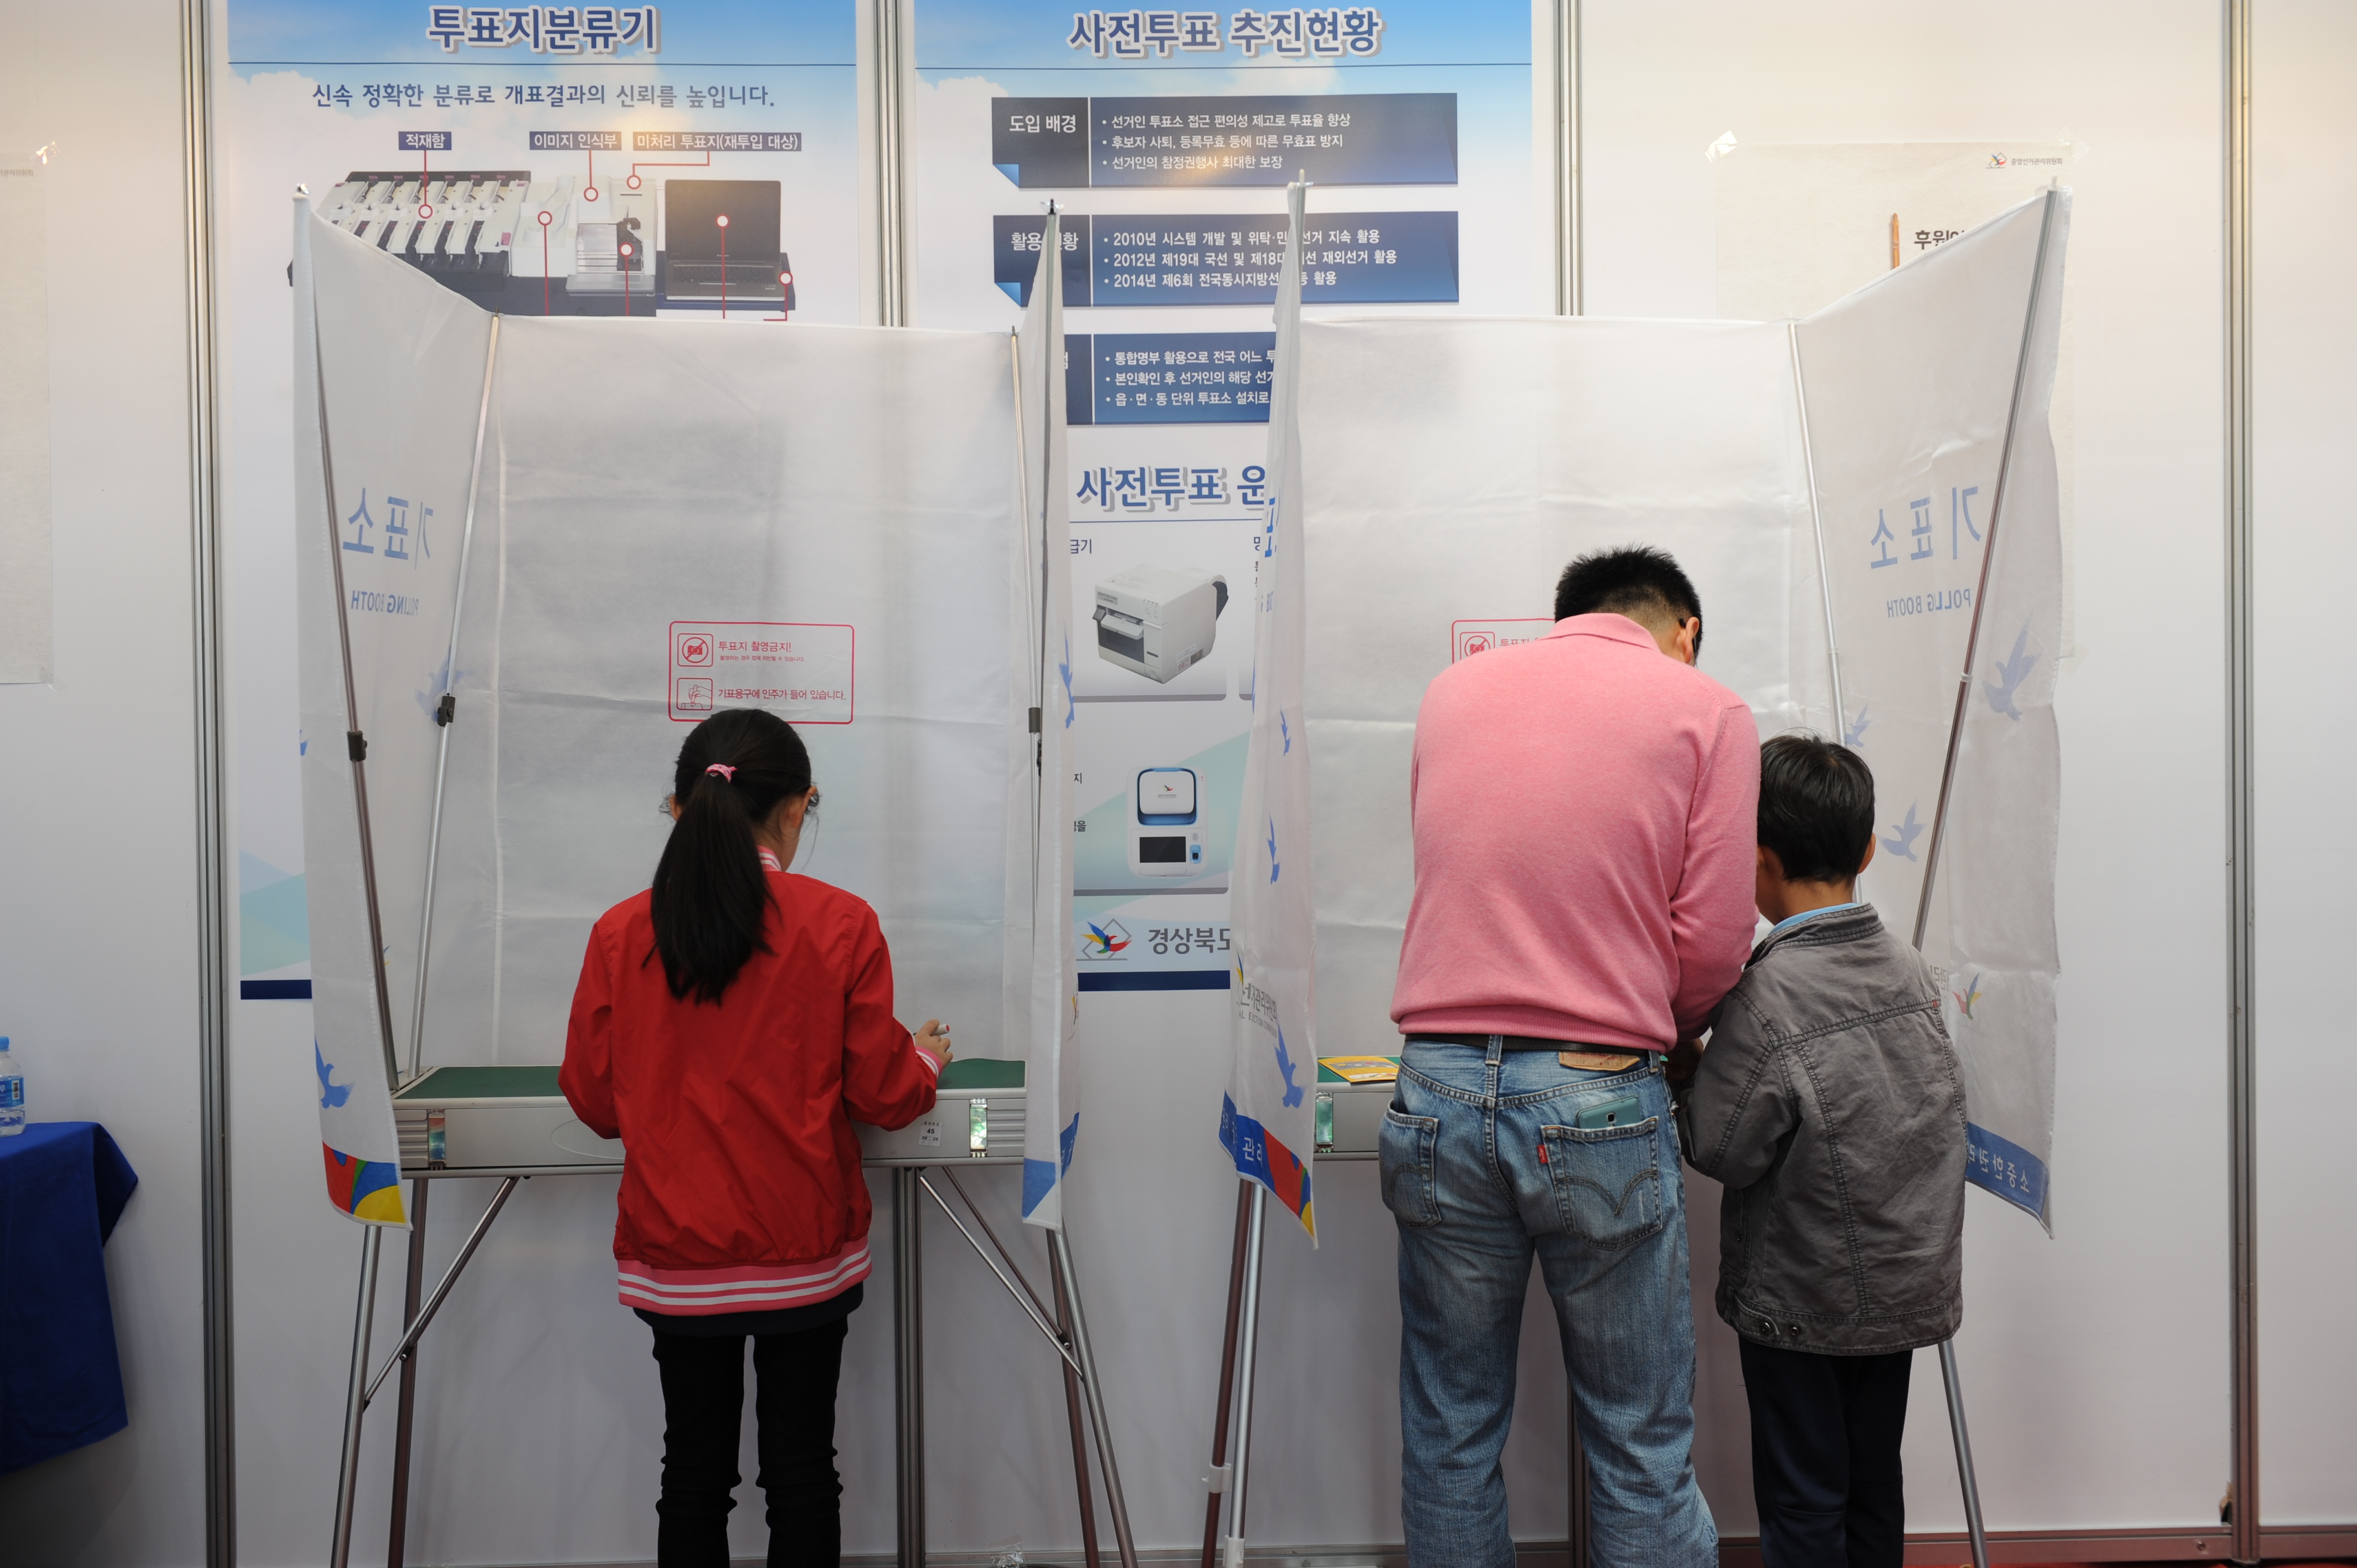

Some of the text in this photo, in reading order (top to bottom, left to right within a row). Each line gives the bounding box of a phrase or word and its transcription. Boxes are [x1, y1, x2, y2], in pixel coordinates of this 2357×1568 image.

[427, 7, 656, 51] 투표지분류기
[1069, 9, 1380, 55] 사전투표 추진현황
[312, 83, 774, 108] 신속 정확한 분류로 개표결과의 신뢰를 높입니다.
[1009, 115, 1076, 133] 도입 배경
[1111, 113, 1351, 129] 선거인 투표소 접근 편의성 제고로 투표율 향상
[405, 133, 445, 149] 적재함
[534, 133, 618, 149] 이미지 인식부
[637, 133, 798, 151] 미처리 투표지(재투입 대상)
[1111, 134, 1342, 149] 후보자 사퇴, 등록무효 등에 따른 무효표 방지
[1112, 155, 1283, 170] 선거인의 참정권행사 최대한 보장
[1011, 233, 1042, 251] 활용
[1113, 231, 1156, 246] 2010년
[1162, 231, 1196, 246] 시스템
[1202, 231, 1226, 246] 개발
[1231, 231, 1242, 246] 및
[1328, 229, 1352, 245] 지속
[1356, 229, 1381, 244] 활용
[1114, 252, 1156, 267] 2012년
[1161, 252, 1199, 267] 제19대
[1204, 252, 1228, 266] 국선
[1233, 252, 1244, 266] 및
[1301, 250, 1317, 265] 선
[1322, 250, 1368, 265] 재외선거
[1373, 249, 1398, 265] 활용
[1114, 273, 1156, 287] 2014년
[1162, 273, 1193, 287] 제6회
[1313, 270, 1337, 286] 활용
[1114, 352, 1160, 366] 통합명부
[1164, 351, 1210, 365] 활용으로
[1213, 350, 1236, 364] 전국
[1239, 350, 1263, 364] 어느
[1115, 372, 1160, 386] 본인확인
[1164, 372, 1176, 385] 후
[1179, 371, 1224, 385] 선거인의
[1228, 370, 1252, 384] 해당
[1115, 391, 1270, 406] 읍·면·동 단위 투표소 설치로
[1075, 467, 1222, 507] 사전투표
[718, 641, 791, 652] 투표지 촬영금지!
[718, 688, 846, 700] 기표용구에 인주가 들어 있습니다.
